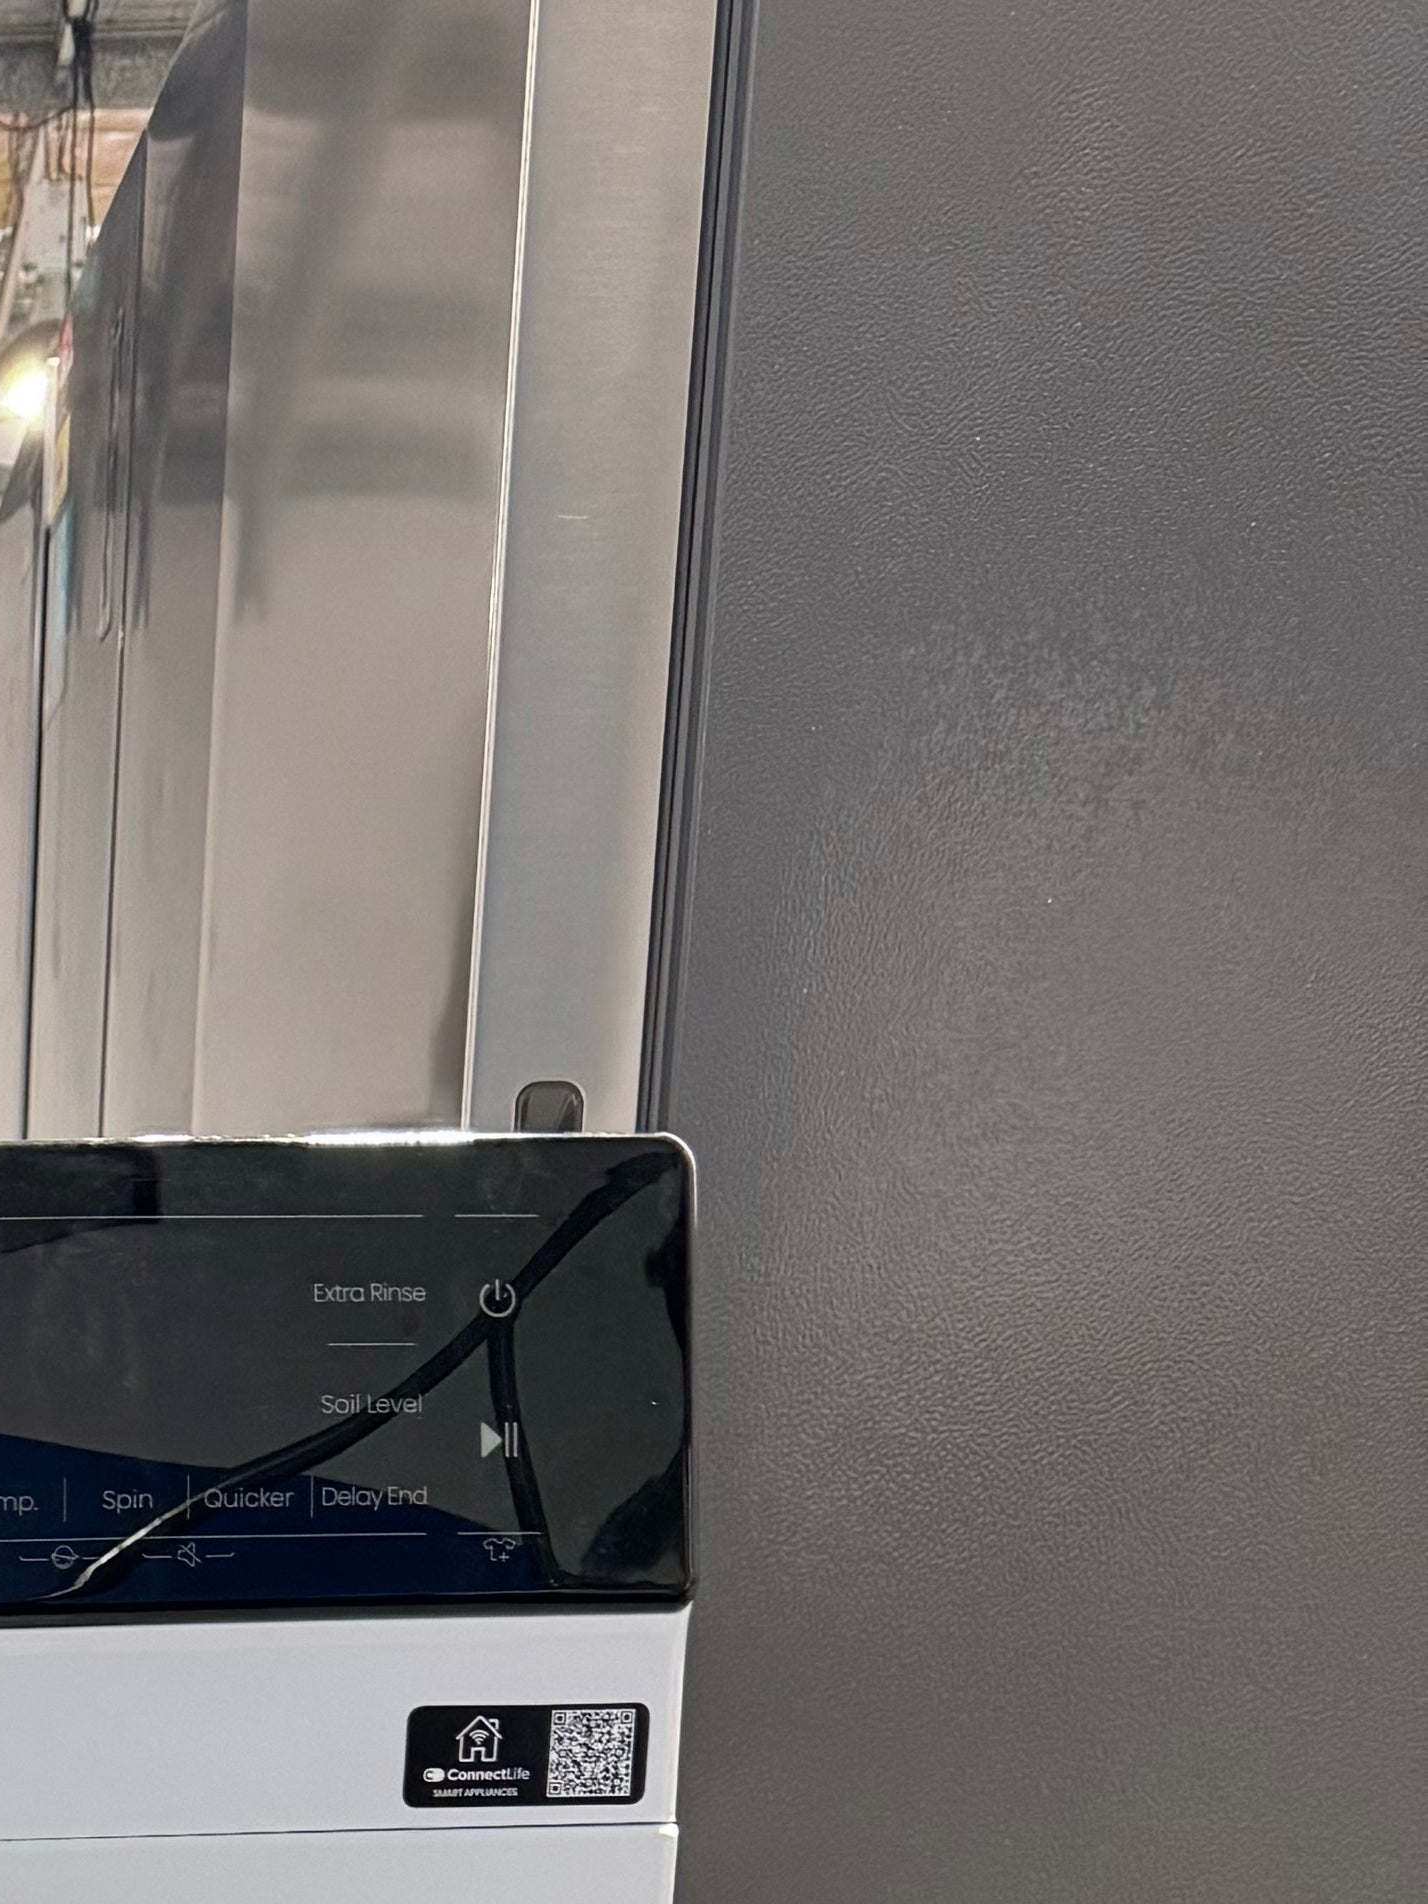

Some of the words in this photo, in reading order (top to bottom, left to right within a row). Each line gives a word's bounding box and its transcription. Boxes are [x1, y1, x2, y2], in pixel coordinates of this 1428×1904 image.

[313, 1282, 365, 1303] Extra
[370, 1282, 426, 1302] Rinse
[320, 1393, 361, 1415] Soil
[366, 1393, 423, 1414] Level
[102, 1488, 154, 1513] Spin
[204, 1487, 294, 1511] Quicker
[321, 1485, 383, 1511] Delay
[387, 1485, 427, 1505] End
[447, 1767, 530, 1782] ConnectLife
[433, 1788, 463, 1797] SMART
[464, 1787, 518, 1797] APPLIANCES
